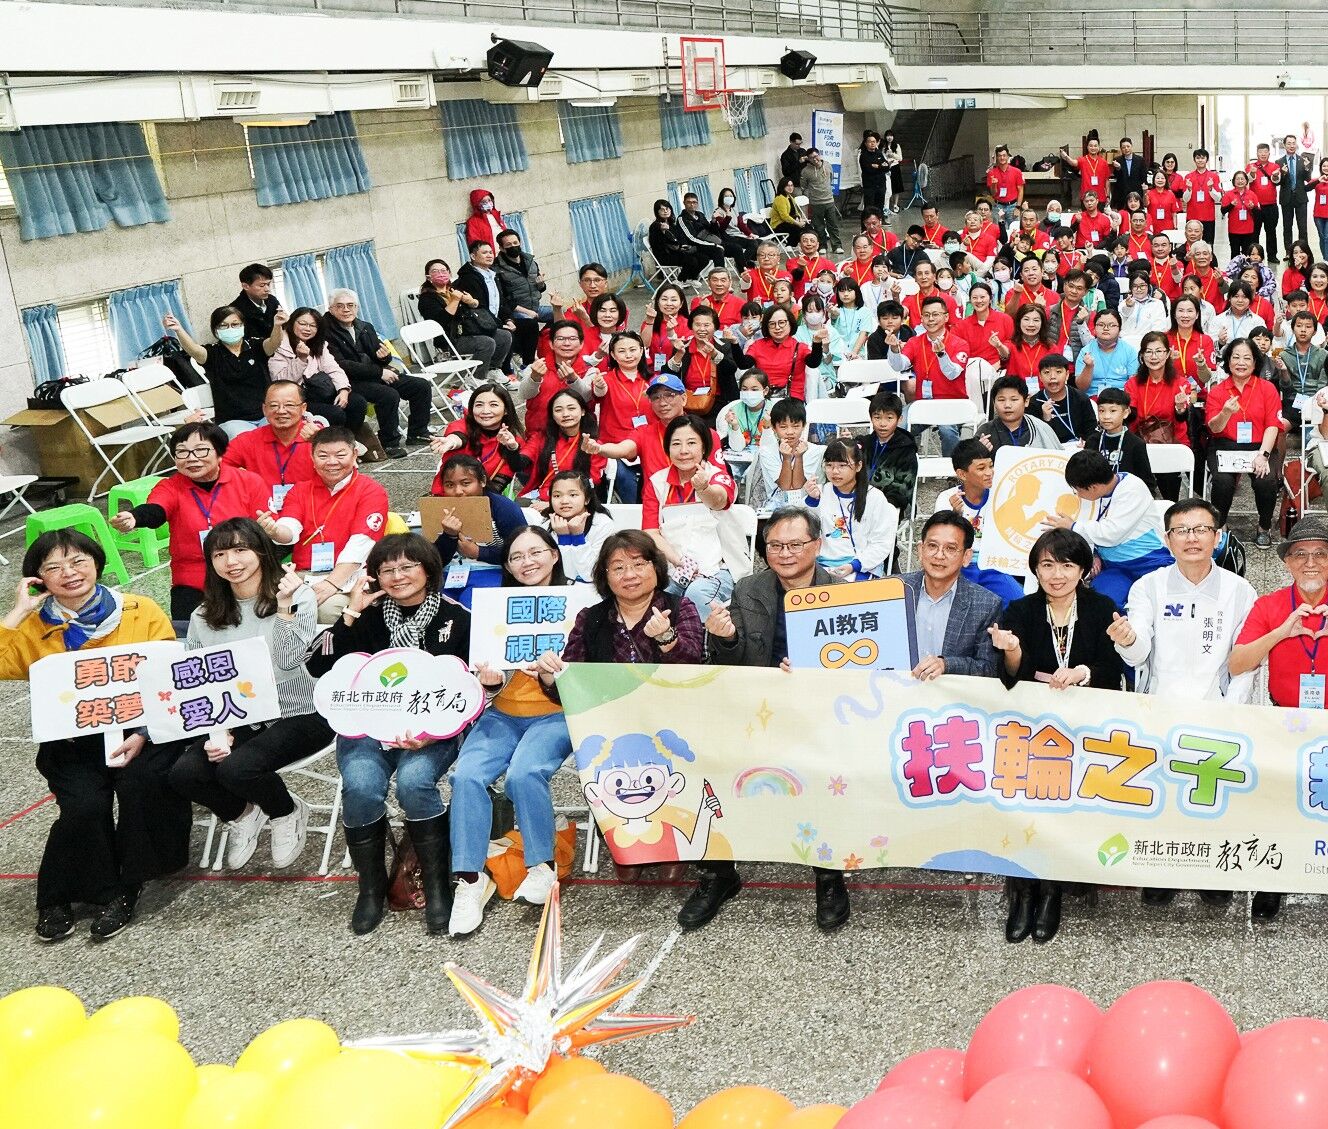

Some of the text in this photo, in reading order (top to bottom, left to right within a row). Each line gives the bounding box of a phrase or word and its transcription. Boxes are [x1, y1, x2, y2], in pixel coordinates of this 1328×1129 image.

[1008, 459, 1053, 483] ROTARY
[506, 595, 567, 624] 國際
[814, 611, 879, 637] AI教育
[504, 633, 565, 663] 視野
[1202, 617, 1214, 655] 張明文
[75, 652, 147, 690] 勇敢
[171, 650, 239, 690] 感恩
[75, 691, 145, 728] 築夢
[179, 691, 248, 732] 愛人
[331, 690, 403, 703] 新北市政府
[901, 715, 1247, 807] 扶輪之子
[1134, 840, 1211, 858] 新北市政府
